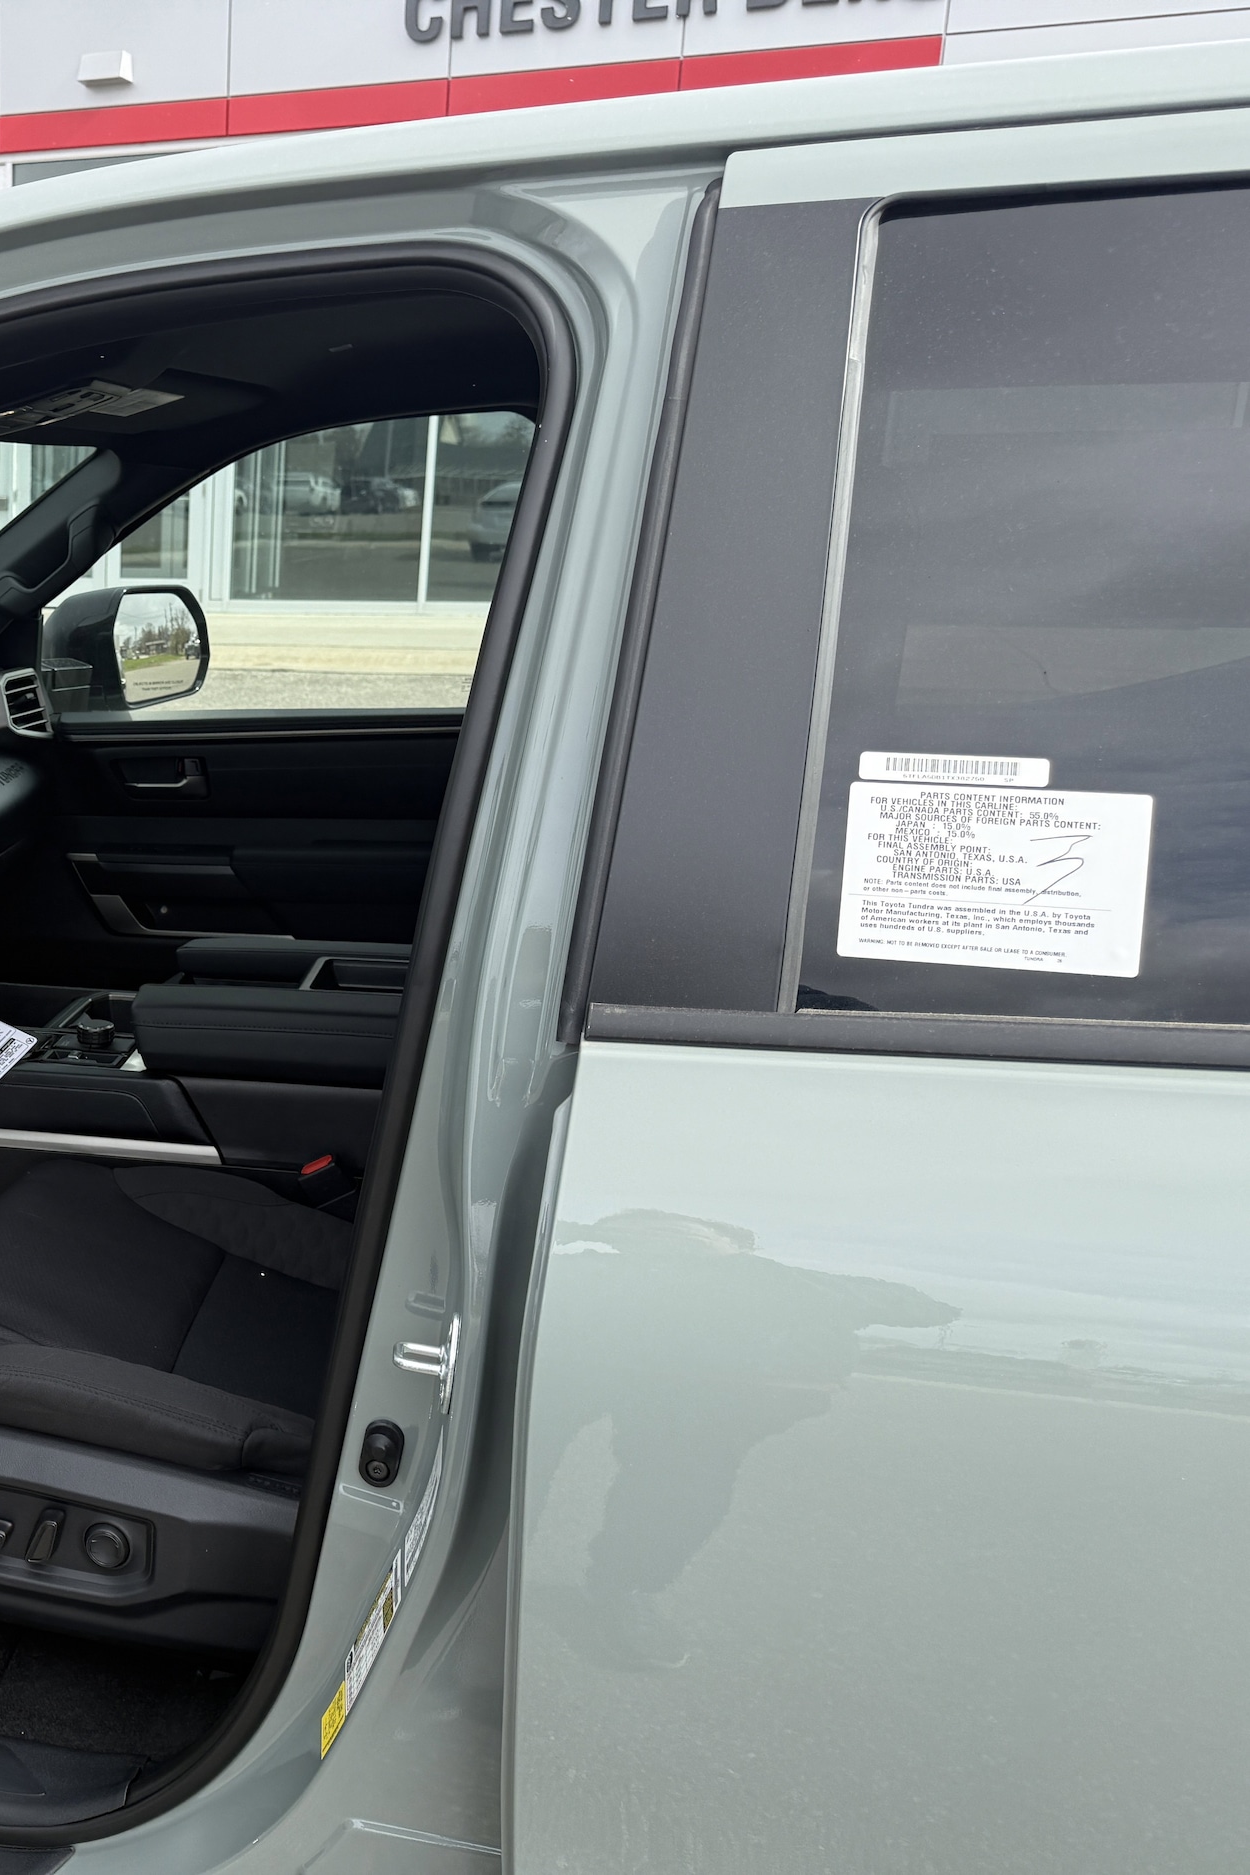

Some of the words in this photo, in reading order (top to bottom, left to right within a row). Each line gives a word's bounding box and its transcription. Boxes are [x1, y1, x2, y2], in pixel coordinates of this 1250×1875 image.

[870, 796, 888, 804] FOR
[891, 797, 934, 806] VEHICLES
[950, 800, 971, 808] THIS
[974, 801, 1017, 810] CARLINE:
[920, 791, 950, 800] PARTS
[953, 793, 995, 802] CONTENT
[999, 795, 1064, 805] INFORMATION
[880, 804, 939, 814] U.S./CANADA
[943, 807, 973, 816] PARTS
[976, 808, 1022, 818] CONTENT:
[1029, 811, 1059, 820] 55.0%
[879, 811, 911, 820] MAJOR
[914, 813, 957, 822] SOURCES
[960, 815, 972, 823] OF
[976, 816, 1016, 825] FOREIGN
[1019, 818, 1050, 827] PARTS
[1053, 820, 1101, 829] CONTENT:
[895, 820, 926, 828] JAPAN
[942, 822, 971, 830] 15.0%
[867, 832, 885, 840] FOR
[888, 833, 909, 842] THIS
[912, 835, 952, 844] VEHICLE:
[895, 827, 930, 835] MEXICO
[947, 830, 975, 838] 15.0%
[877, 840, 903, 849] FINAL
[906, 842, 956, 851] ASSEMBLY
[959, 845, 990, 853] POINT:
[876, 855, 919, 864] COUNTRY
[922, 857, 934, 865] OF
[937, 858, 972, 867] ORIGIN:
[915, 850, 958, 859] ANTONIO,
[962, 852, 995, 862] TEXAS,
[998, 854, 1027, 863] U.S.A.
[892, 863, 925, 872] ENGINE
[929, 865, 962, 874] PARTS:
[965, 868, 994, 876] U.S.A.
[892, 870, 961, 882] TRANSMISSION
[964, 875, 998, 884] PARTS:
[1002, 877, 1021, 885] USA
[885, 908, 942, 918] Manufacturing,
[946, 912, 970, 920] Texas,
[1054, 919, 1095, 928] thousands
[1064, 912, 1091, 920] Toyota
[869, 914, 906, 923] American
[1012, 924, 1045, 933] Antonio,
